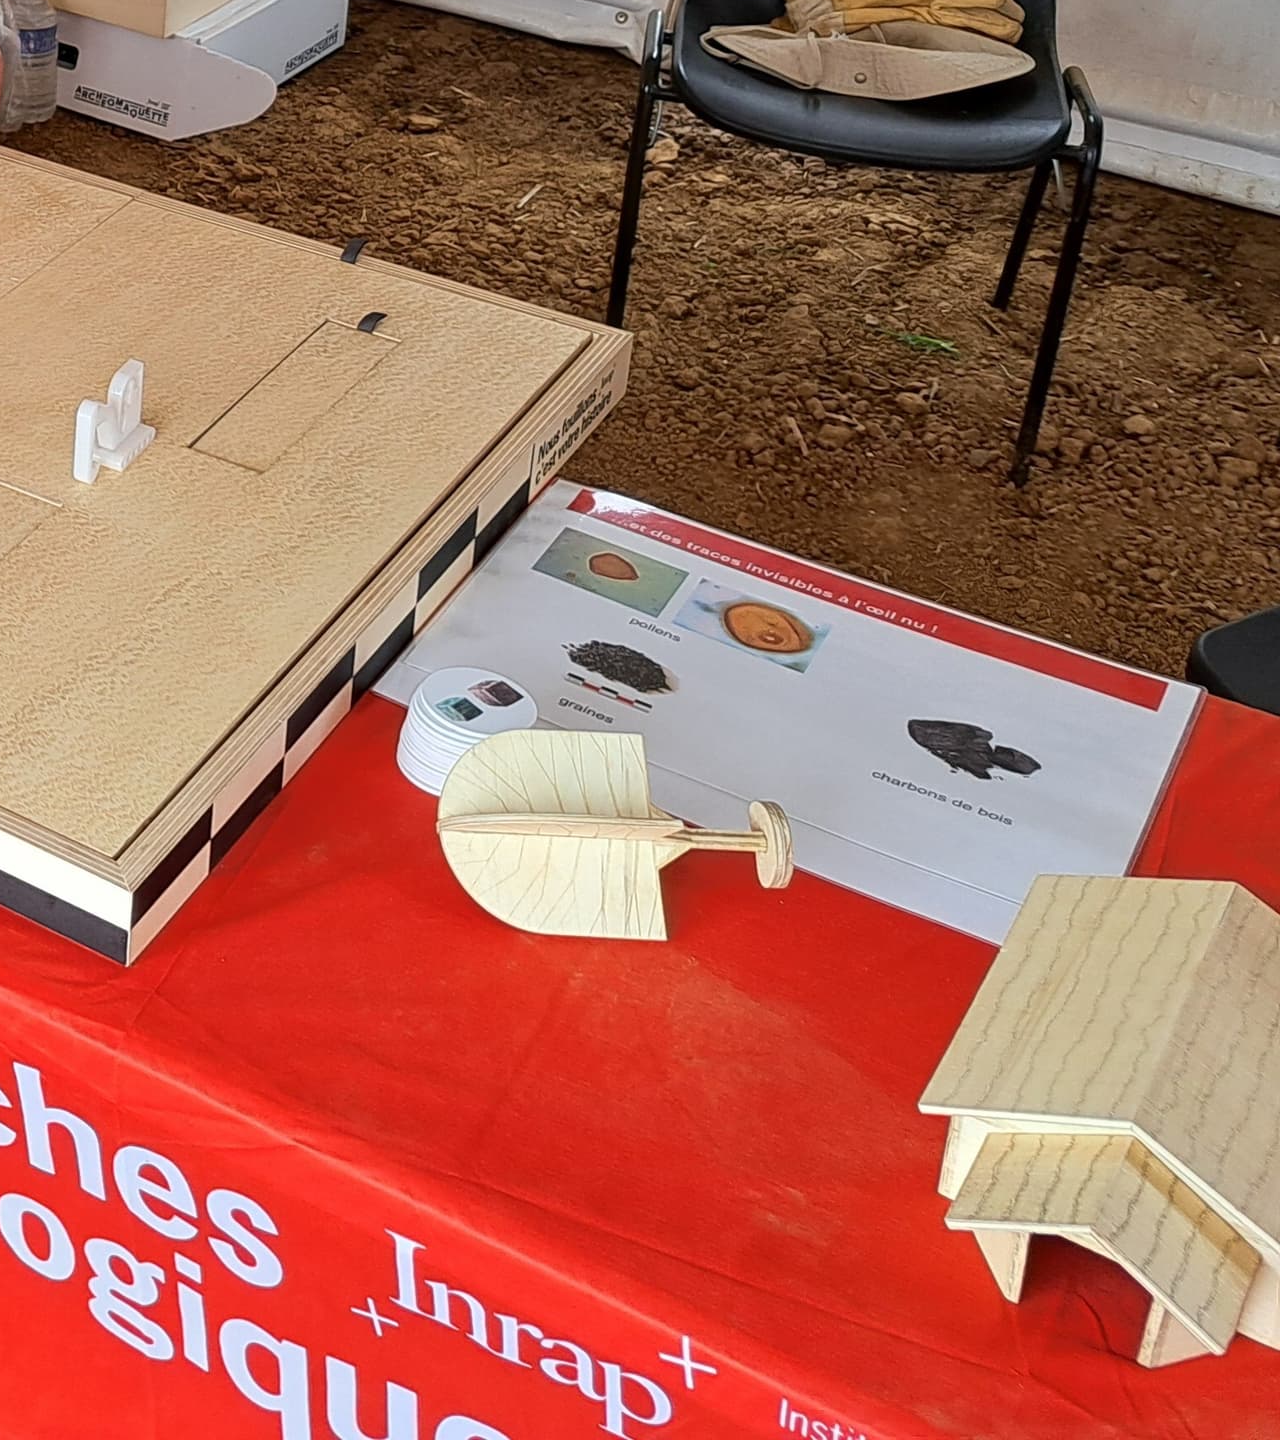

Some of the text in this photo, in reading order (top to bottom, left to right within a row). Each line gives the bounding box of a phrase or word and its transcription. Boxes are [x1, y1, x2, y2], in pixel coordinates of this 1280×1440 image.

[649, 528, 682, 548] des
[687, 541, 741, 567] traces
[746, 562, 833, 600] invisibles
[838, 592, 851, 605] à
[901, 616, 927, 631] nu
[930, 622, 939, 634] !
[629, 617, 681, 642] pollens
[558, 697, 614, 724] graines
[871, 770, 1013, 826] charbons de bois
[384, 1228, 673, 1440] Inrap
